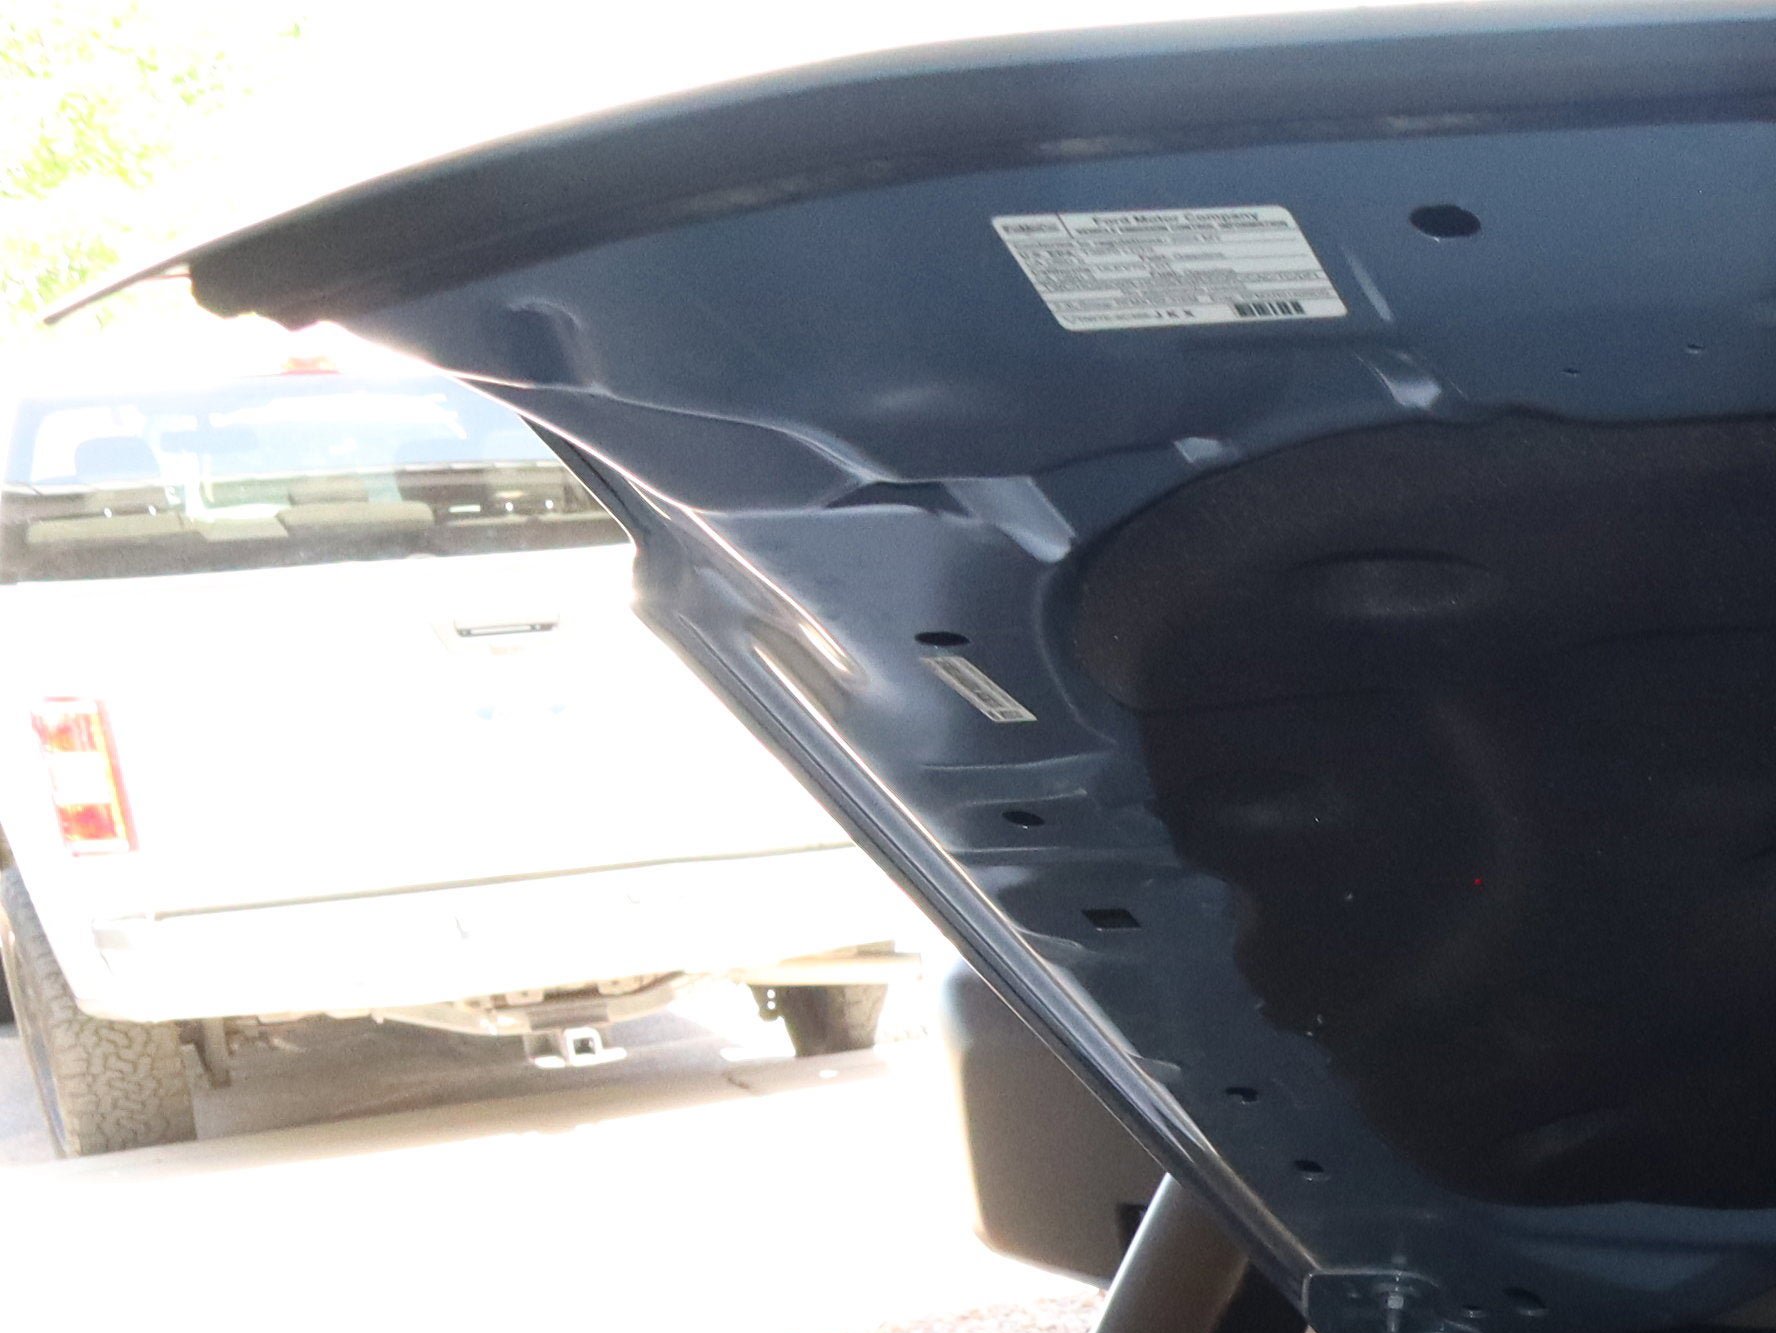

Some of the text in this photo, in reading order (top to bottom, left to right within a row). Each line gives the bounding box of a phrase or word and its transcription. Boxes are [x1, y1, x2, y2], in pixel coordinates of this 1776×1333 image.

[1092, 211, 1260, 226] Ford Motor Company
